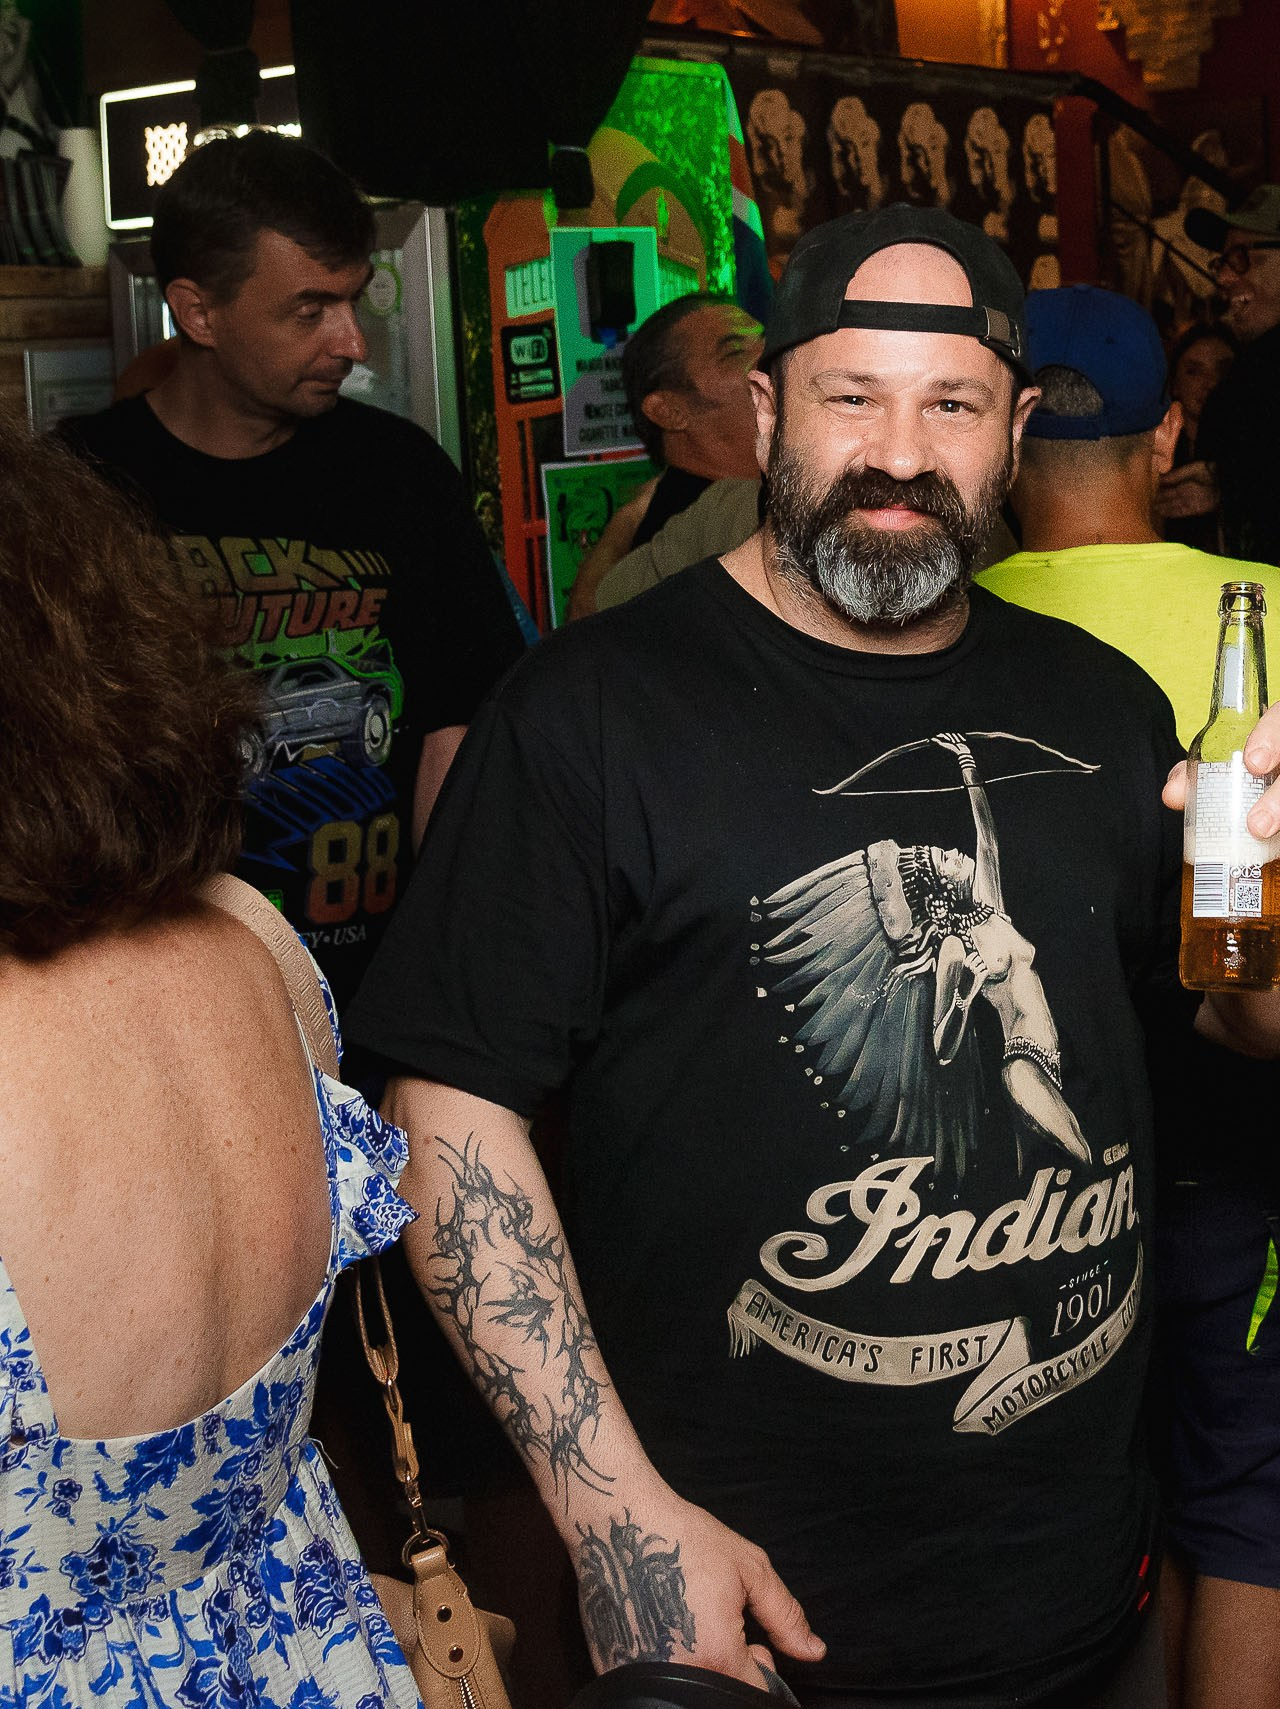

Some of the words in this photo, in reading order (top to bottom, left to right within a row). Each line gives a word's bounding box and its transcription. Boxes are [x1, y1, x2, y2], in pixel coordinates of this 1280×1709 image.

[508, 257, 553, 308] TELE
[167, 534, 342, 594] ACK
[214, 587, 388, 648] UTURE
[306, 812, 400, 924] 88
[759, 1156, 1138, 1292] Indian
[745, 1291, 883, 1374] AMERICA'S
[910, 1333, 990, 1375] FIRST
[1050, 1273, 1112, 1338] 1901
[981, 1329, 1110, 1432] MOTORCYCLE
